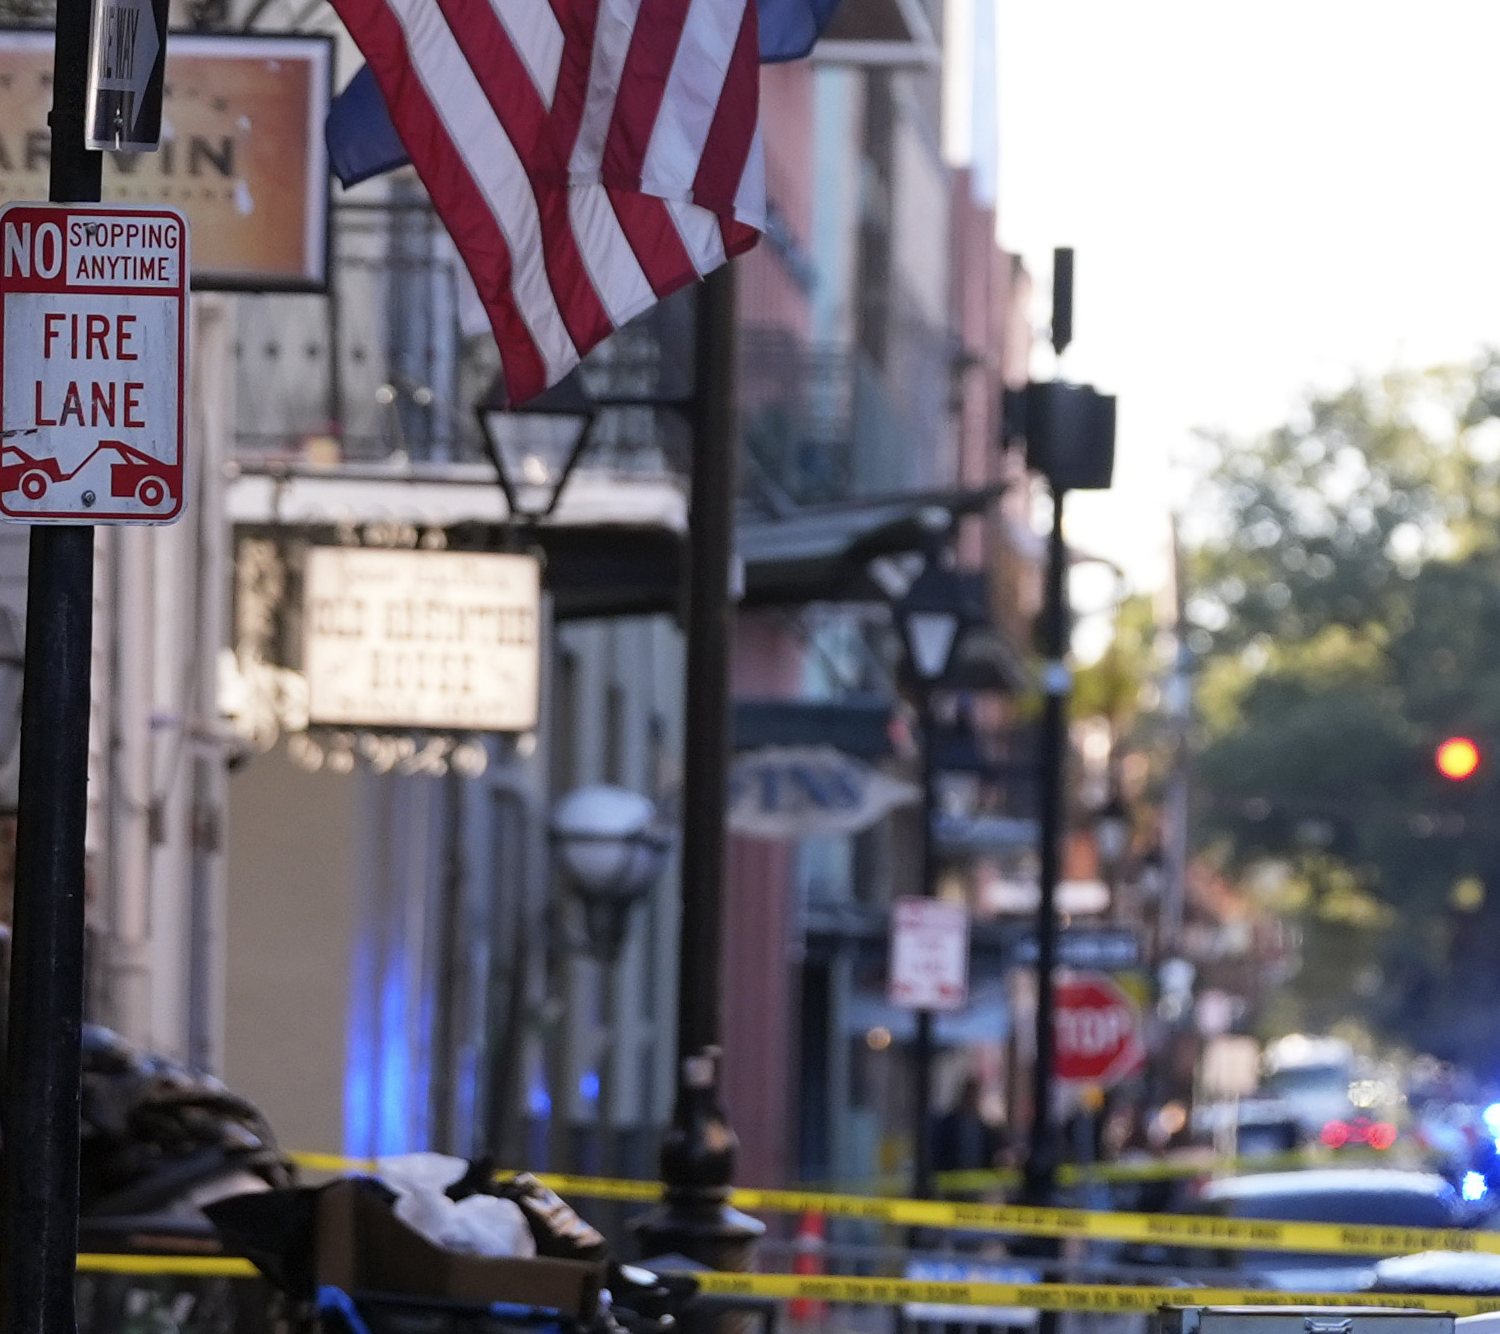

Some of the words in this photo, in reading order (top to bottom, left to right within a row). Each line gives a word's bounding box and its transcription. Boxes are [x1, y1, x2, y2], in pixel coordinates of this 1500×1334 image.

[3, 221, 63, 280] NO
[69, 221, 178, 250] STOPPING
[75, 254, 171, 282] ANYTIME
[43, 312, 139, 361] FIRE
[34, 380, 146, 428] LANE
[1054, 1008, 1130, 1052] TOP
